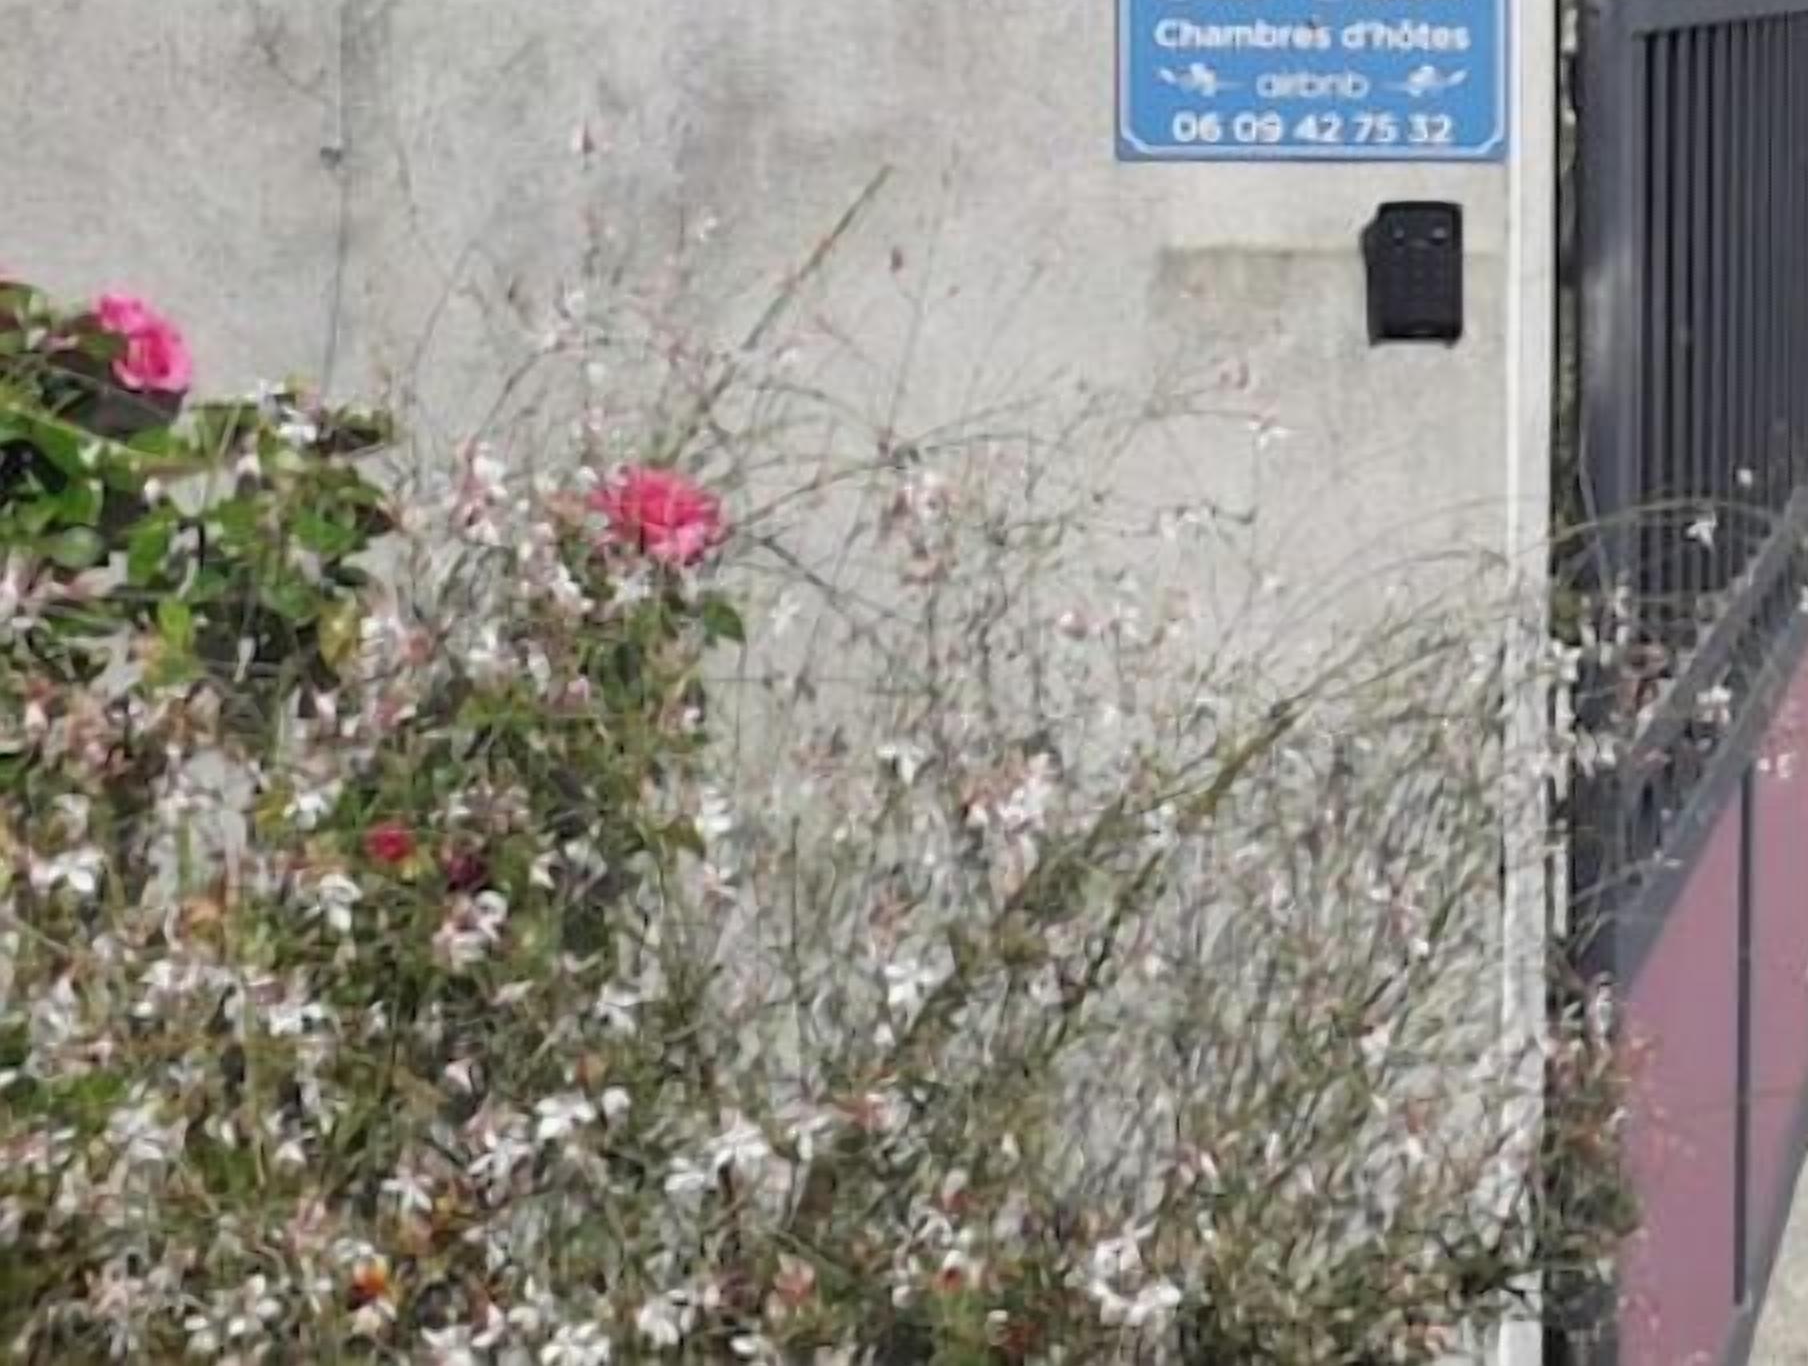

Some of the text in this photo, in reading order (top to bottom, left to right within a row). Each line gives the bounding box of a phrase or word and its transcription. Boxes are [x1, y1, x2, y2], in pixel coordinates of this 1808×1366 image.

[1154, 18, 1471, 50] Chambres d'hôtes
[1256, 71, 1369, 98] airbnb
[1172, 112, 1454, 142] 06 09 42 75 32
